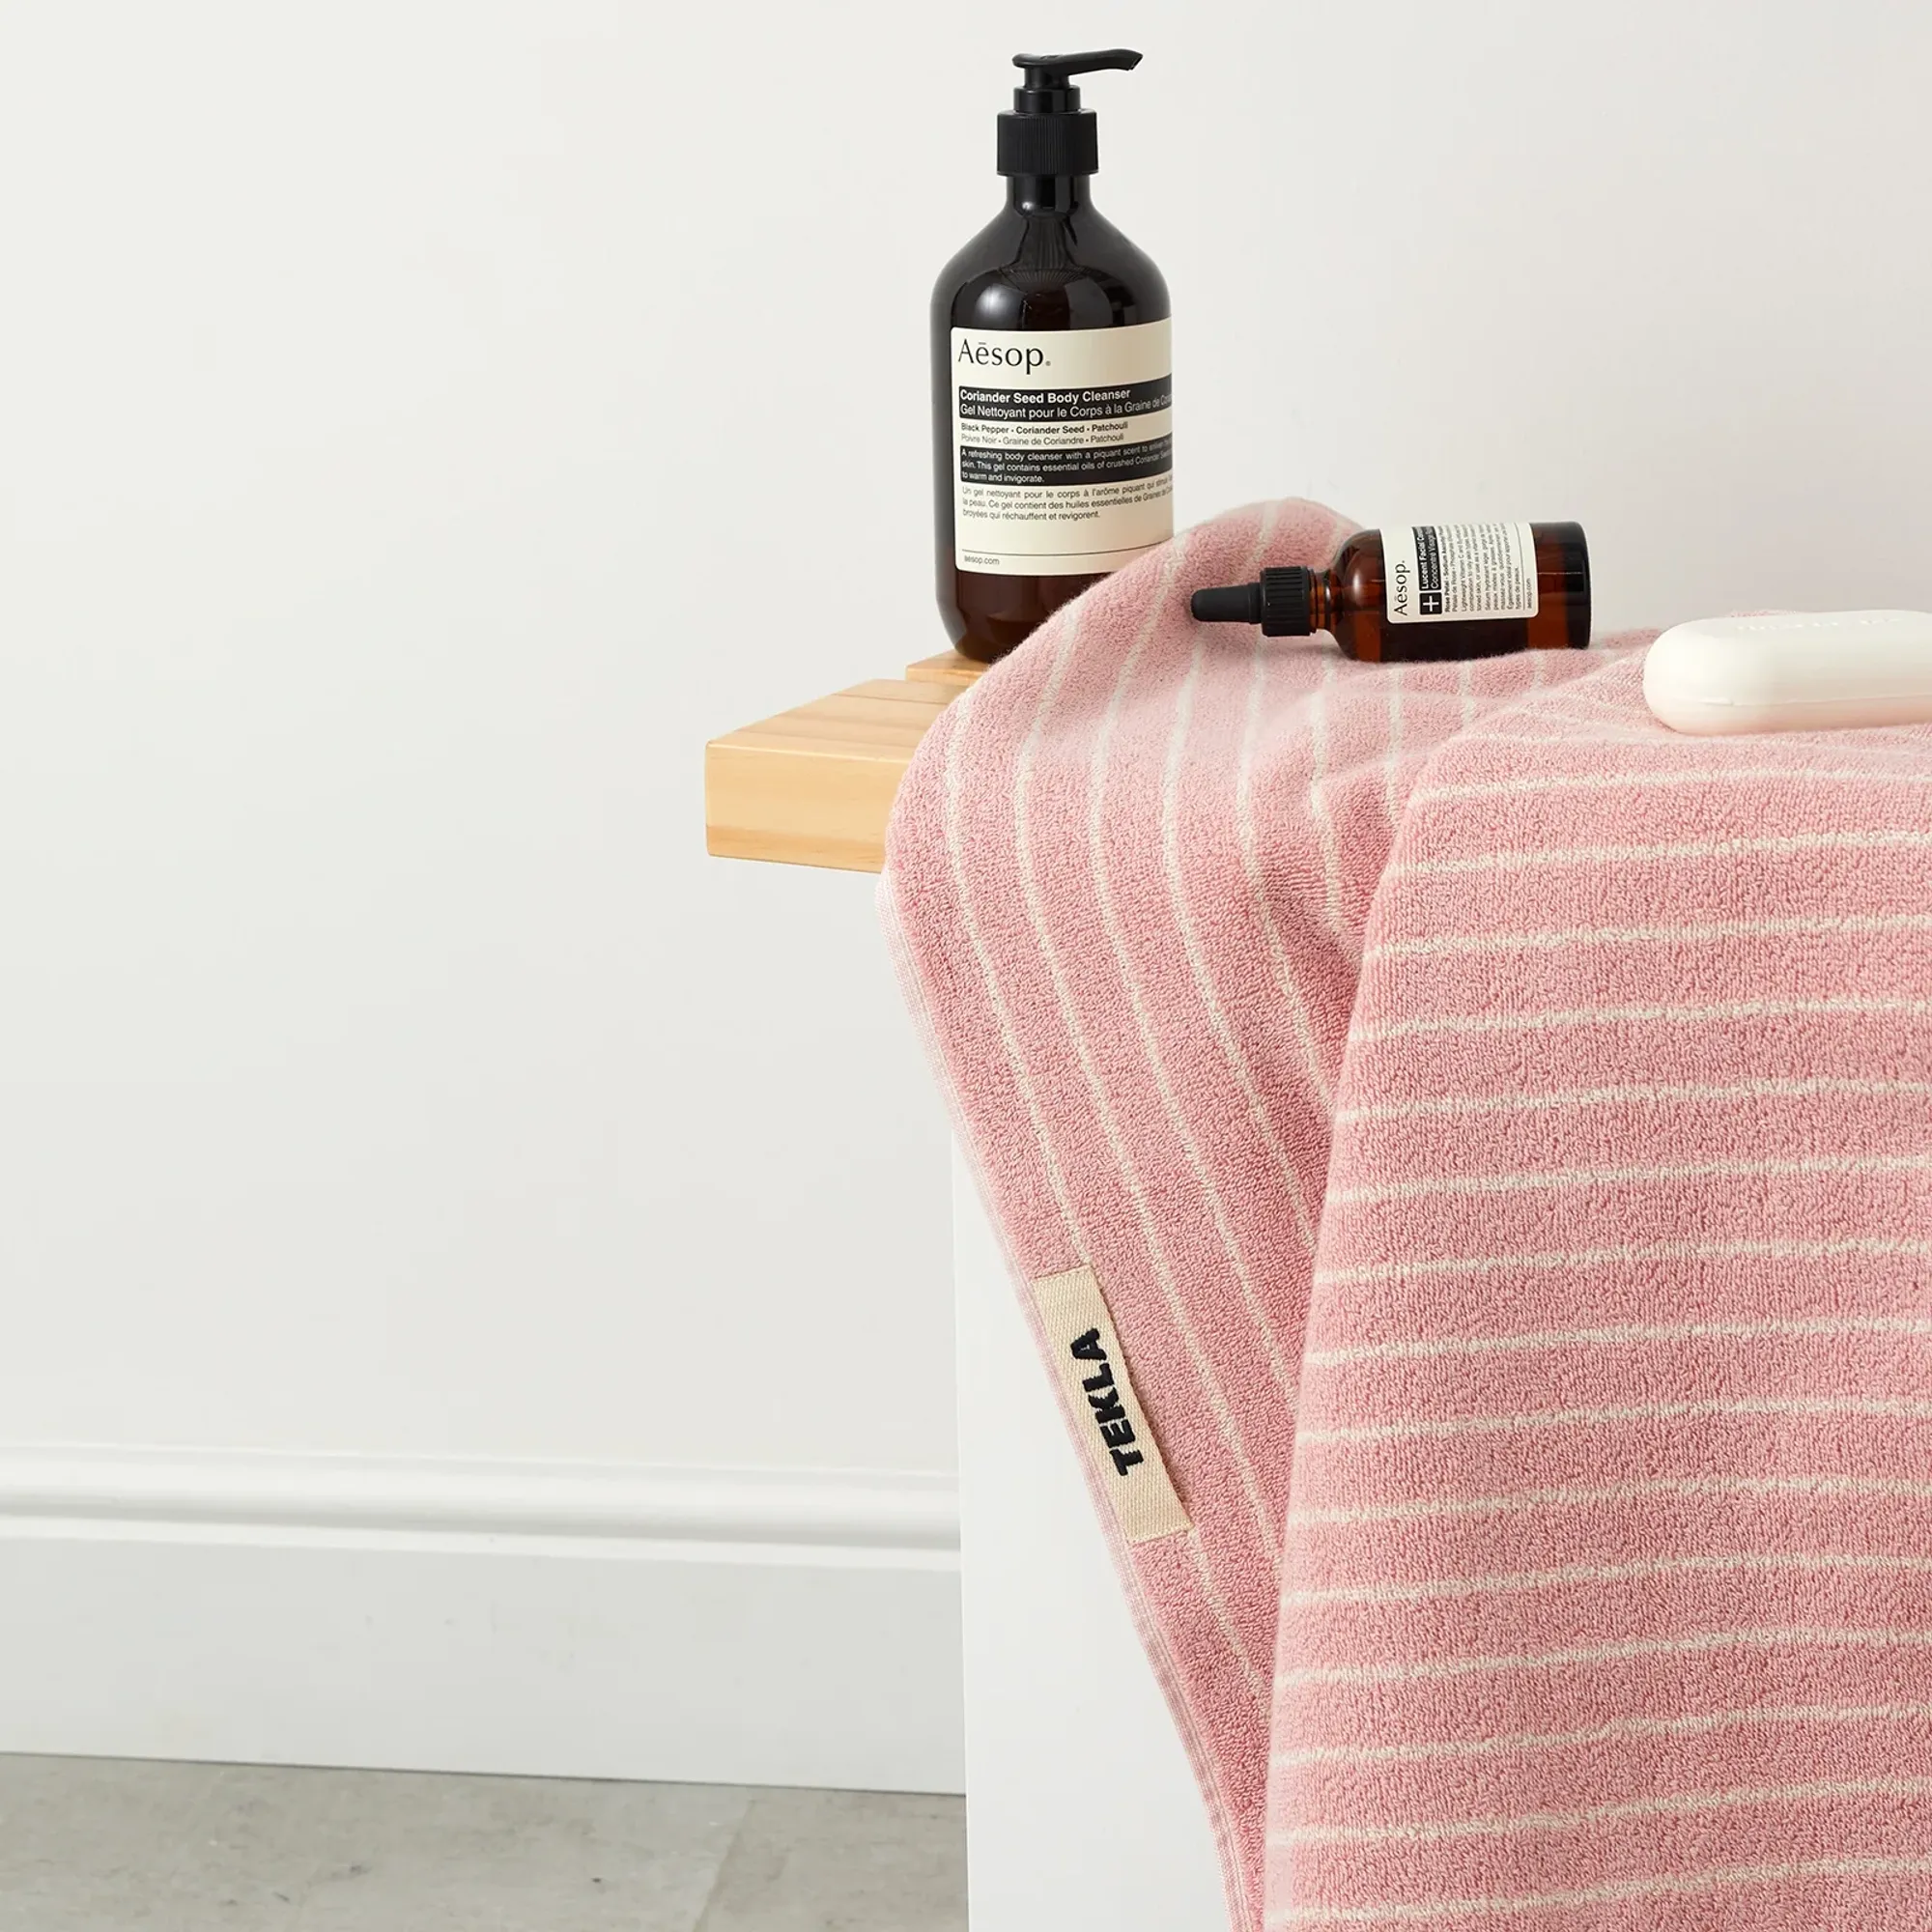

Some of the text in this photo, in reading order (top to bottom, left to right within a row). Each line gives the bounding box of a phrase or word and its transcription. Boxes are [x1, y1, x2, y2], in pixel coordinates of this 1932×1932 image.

[960, 389, 1130, 405] Coriander Seed Body Cleanser
[960, 404, 975, 414] Gel
[978, 406, 1026, 419] Nettoyant
[1029, 409, 1054, 420] pour
[1057, 408, 1066, 417] le
[1070, 407, 1102, 417] Corps
[1105, 405, 1112, 414] à
[1114, 404, 1122, 413] la
[1124, 402, 1151, 412] Graine
[1152, 399, 1159, 408] de
[981, 425, 1009, 434] Pepper
[1016, 426, 1060, 435] Coriander
[1063, 425, 1084, 434] Seed
[1092, 421, 1128, 432] Patchouli
[1091, 433, 1123, 443] Patchouli
[968, 450, 1002, 461] refreshing
[1005, 453, 1025, 462] body
[1094, 449, 1121, 459] piquant
[976, 461, 991, 470] This
[1106, 459, 1134, 469] crushed
[1004, 474, 1044, 484] invigorate.
[986, 490, 1021, 498] nettoyant
[988, 499, 999, 508] Ce
[1002, 512, 1046, 521] réchauffent
[1069, 1327, 1144, 1477] TEKLA
